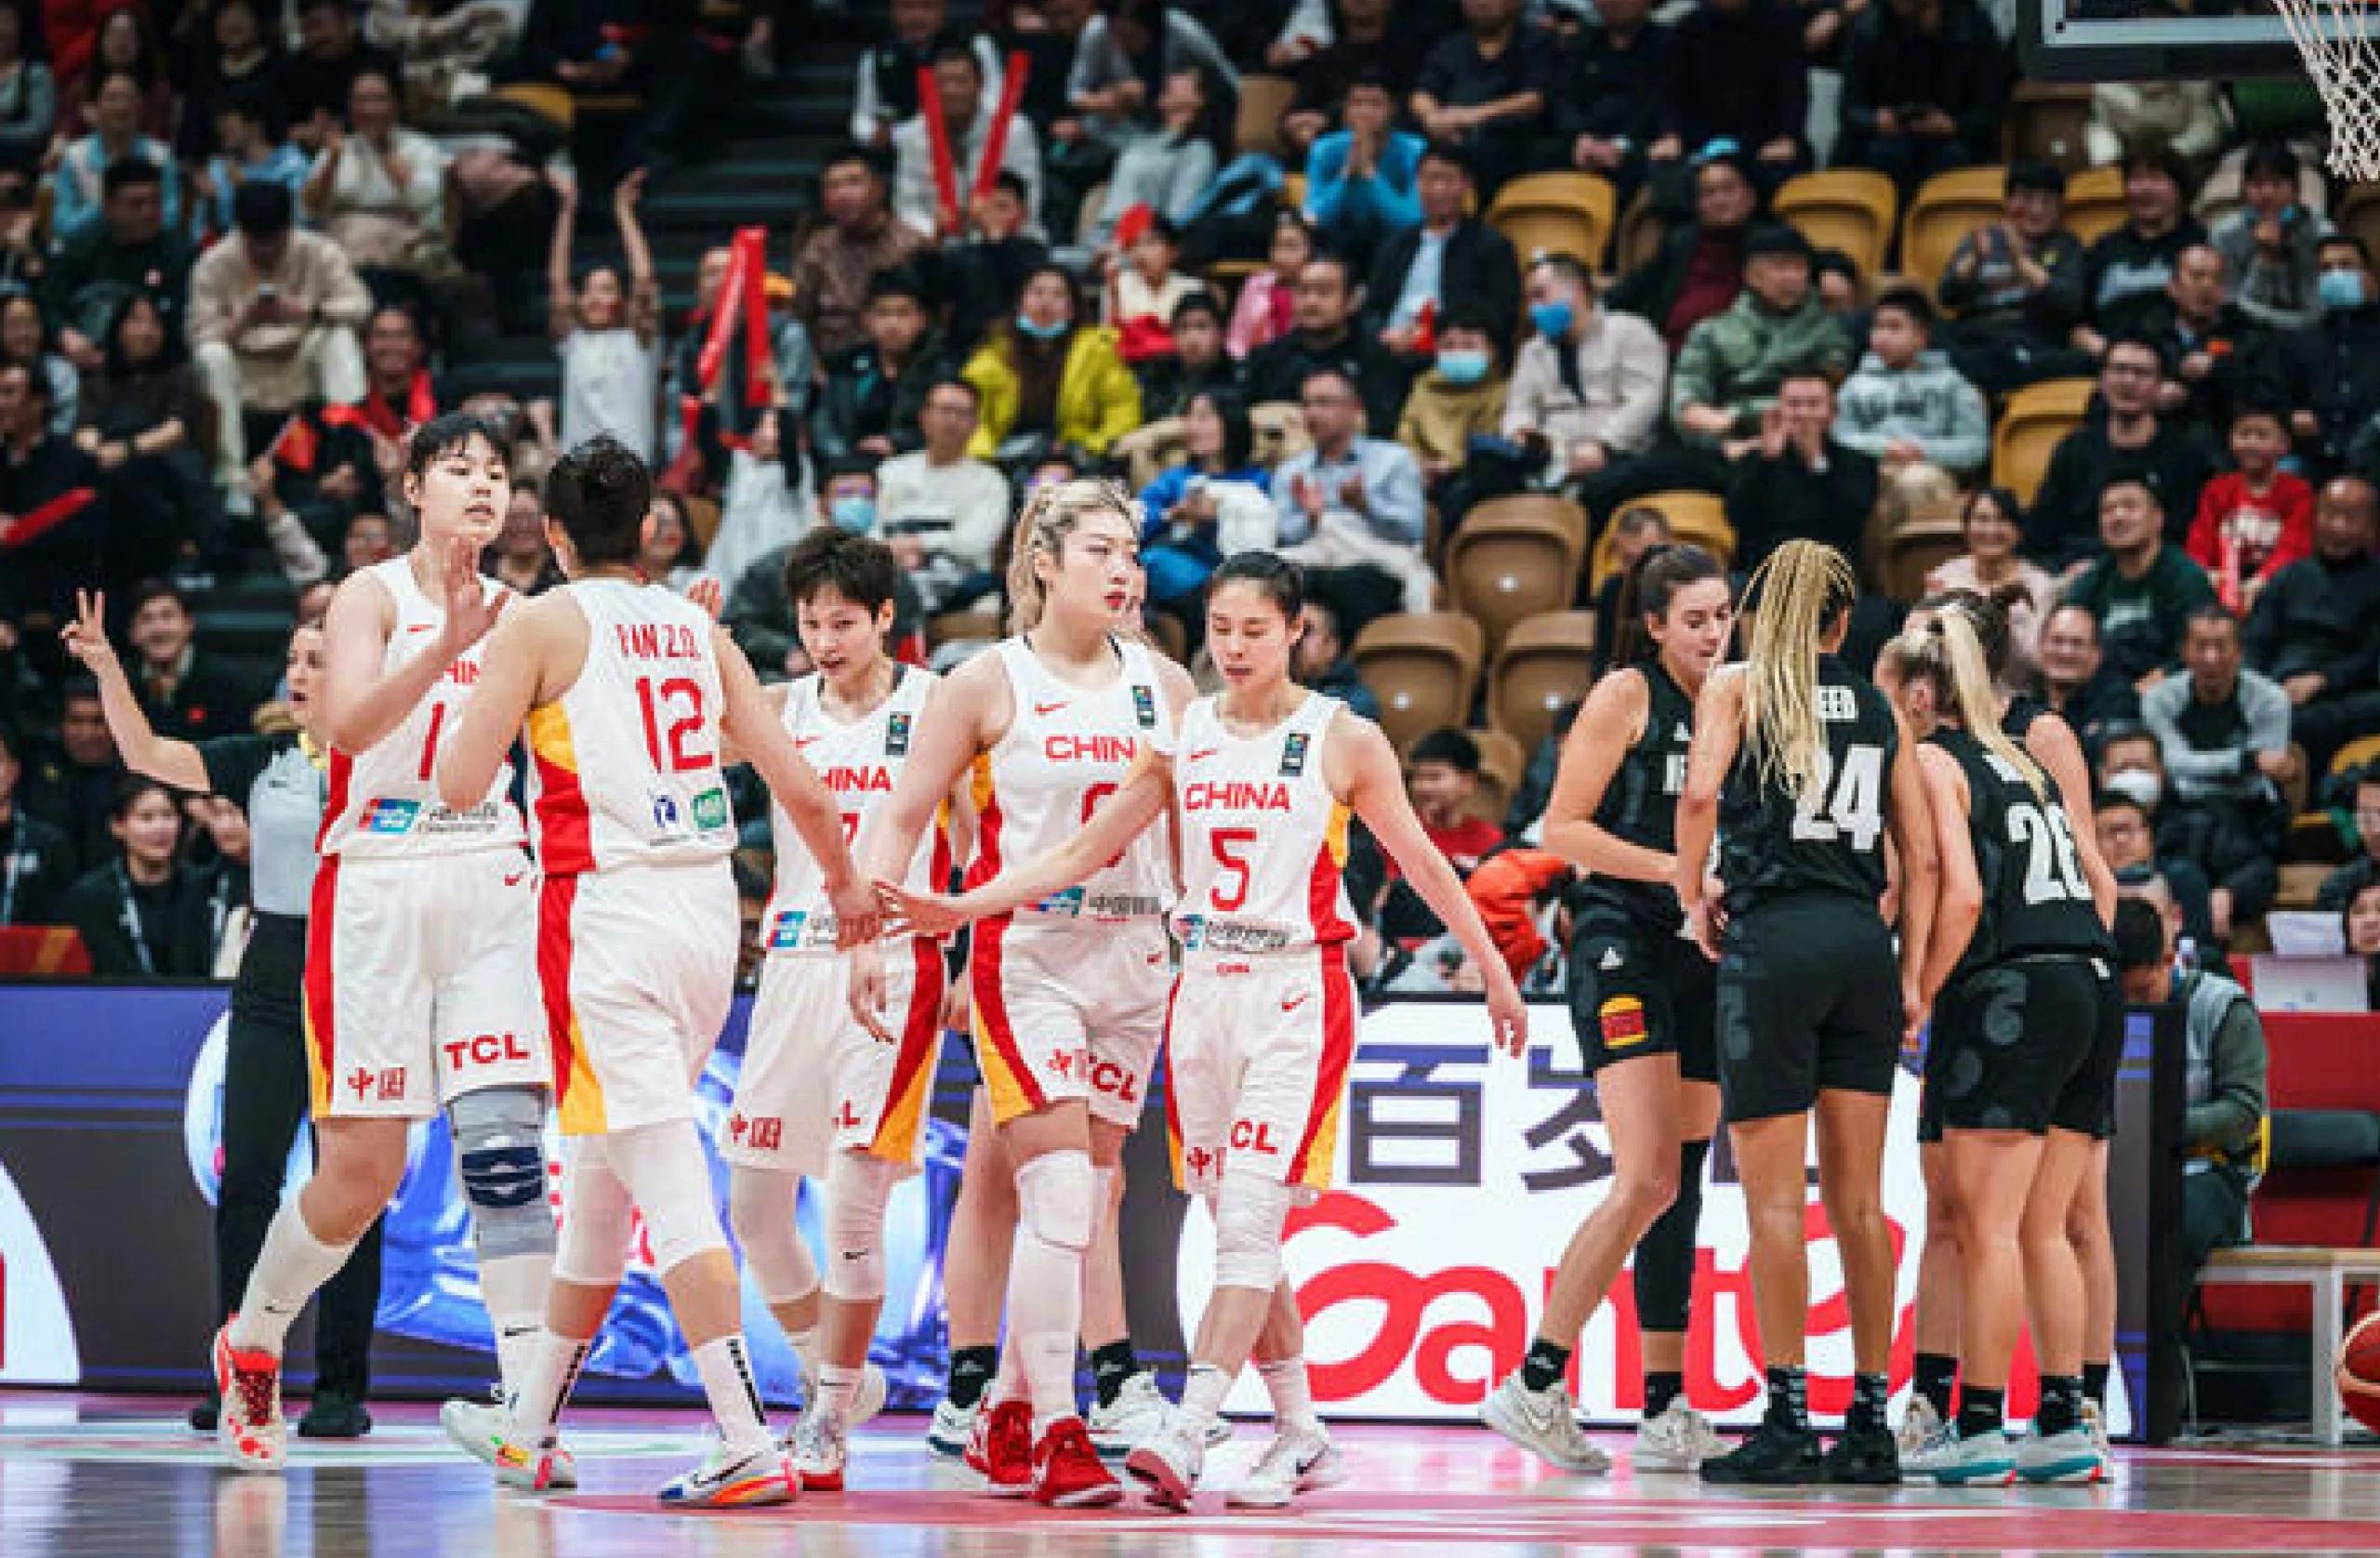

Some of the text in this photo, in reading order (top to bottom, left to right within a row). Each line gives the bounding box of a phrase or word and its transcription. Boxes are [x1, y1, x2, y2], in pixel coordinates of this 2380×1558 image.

[1816, 685, 1858, 721] EED
[419, 702, 444, 779] 1
[635, 677, 713, 773] 12
[1045, 734, 1136, 762] CHIN
[821, 765, 892, 792] HINA
[1185, 781, 1292, 812] CHINA
[1210, 825, 1257, 913] 5
[443, 1031, 532, 1071] TCL
[348, 1067, 406, 1102] 中国
[1088, 1051, 1138, 1103] CL
[1230, 1117, 1279, 1155] CL
